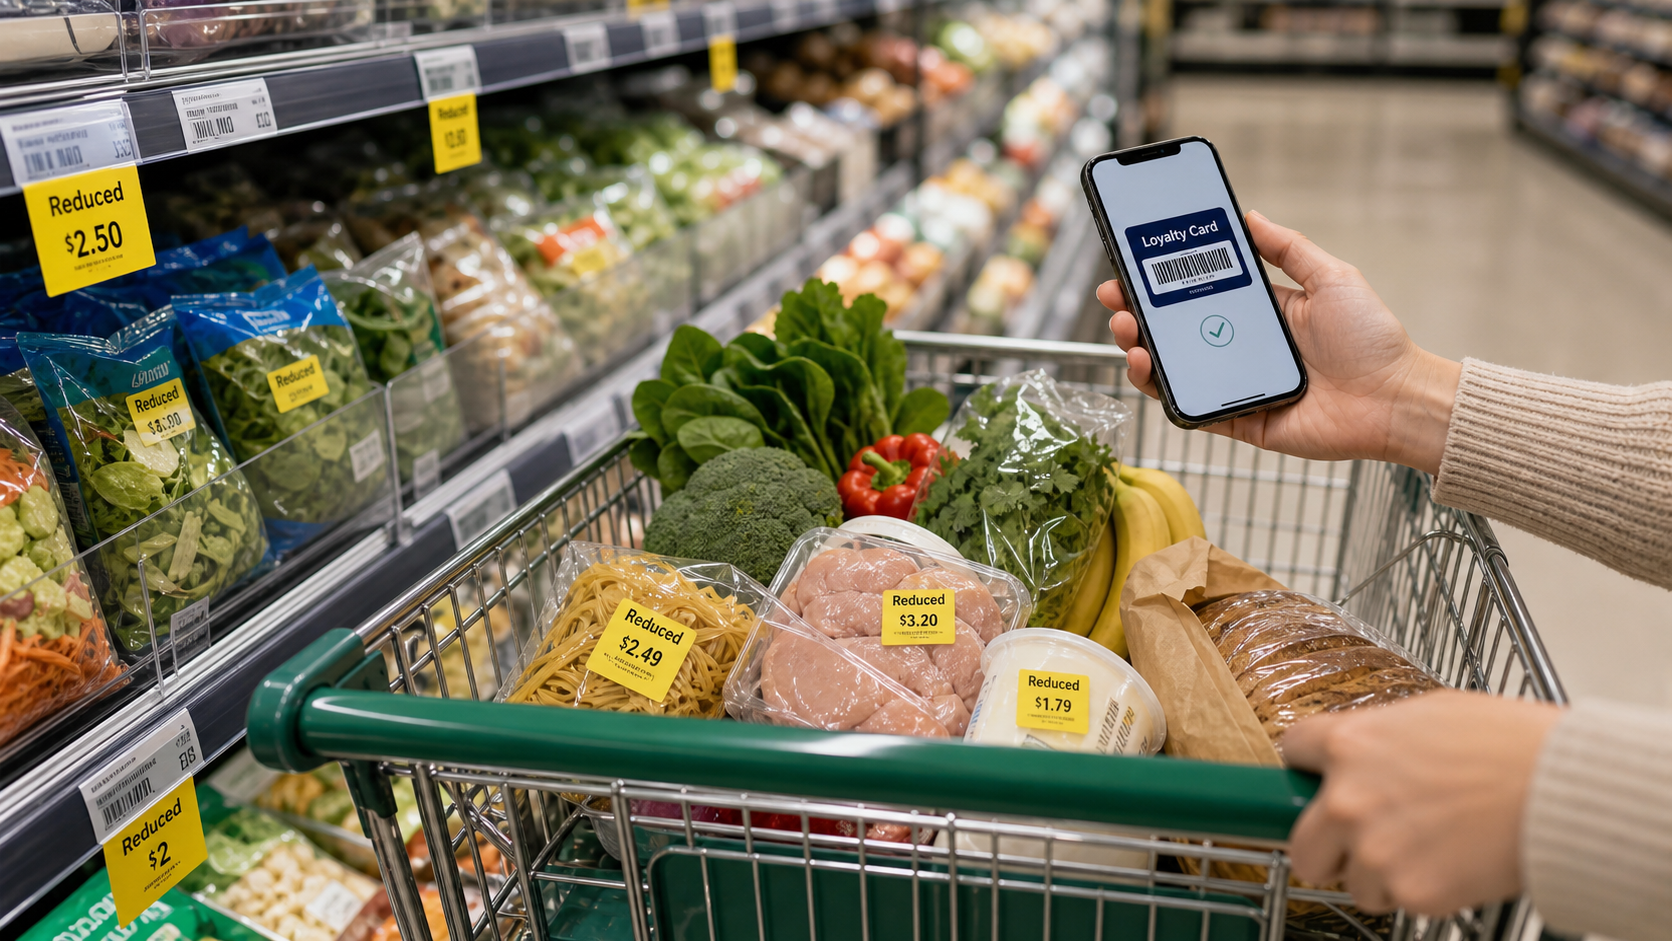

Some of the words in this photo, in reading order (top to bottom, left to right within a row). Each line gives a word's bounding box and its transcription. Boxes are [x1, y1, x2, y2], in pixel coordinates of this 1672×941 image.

[48, 180, 124, 217] Reduced
[64, 220, 123, 258] $2.50
[1141, 230, 1187, 248] Loyalty
[1188, 220, 1219, 237] Card
[275, 362, 316, 389] Reduced
[134, 385, 180, 413] Reduced
[892, 593, 946, 607] Reduced
[624, 607, 685, 646] Reduced
[899, 613, 938, 627] $3.20
[618, 634, 664, 668] $2.49
[1028, 674, 1080, 692] Reduced
[1034, 695, 1072, 713] $1.79
[121, 797, 183, 857] Reduced
[148, 841, 172, 872] $2
